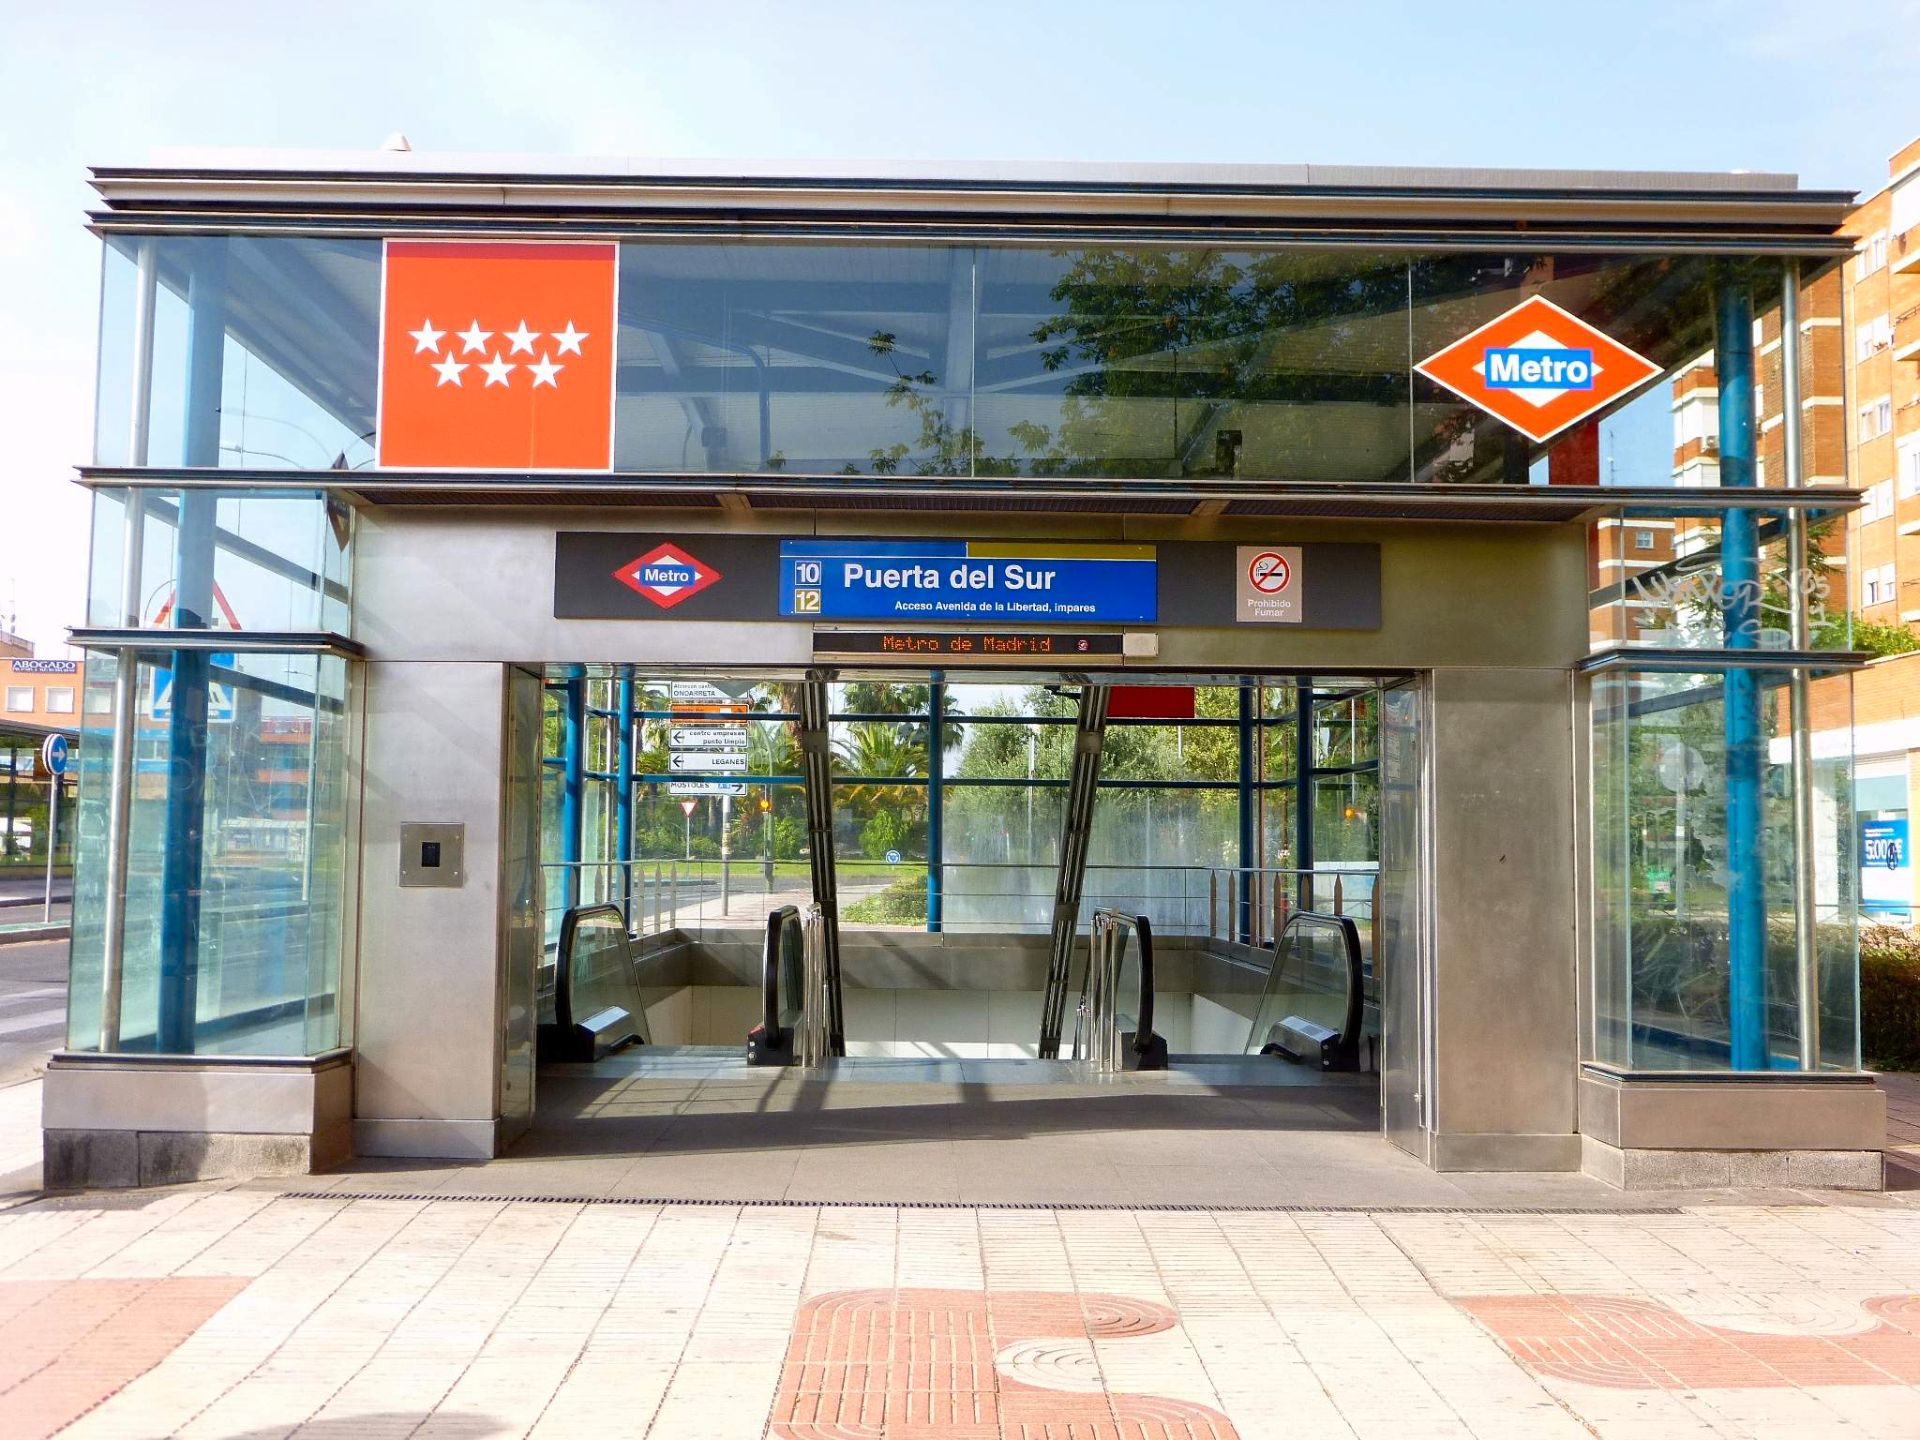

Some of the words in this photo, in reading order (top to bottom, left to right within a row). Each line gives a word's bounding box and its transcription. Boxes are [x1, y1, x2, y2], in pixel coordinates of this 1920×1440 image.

[1490, 353, 1589, 384] Metro
[644, 568, 689, 582] Metro
[796, 563, 819, 583] 10
[844, 563, 940, 589] Puerta
[950, 564, 994, 590] del
[1004, 564, 1056, 590] Sur
[796, 591, 819, 611] 12
[895, 601, 932, 611] Acceso
[936, 601, 976, 612] Avenida
[979, 602, 992, 612] de
[995, 602, 1004, 612] la
[1007, 602, 1051, 614] Libertad,
[1054, 602, 1096, 614] impares
[1247, 599, 1291, 608] Prohibido
[1254, 608, 1285, 617] Fumar
[883, 635, 939, 651] Metro
[950, 636, 972, 652] de
[983, 636, 1050, 652] Madrid
[13, 660, 76, 669] ABOGADO
